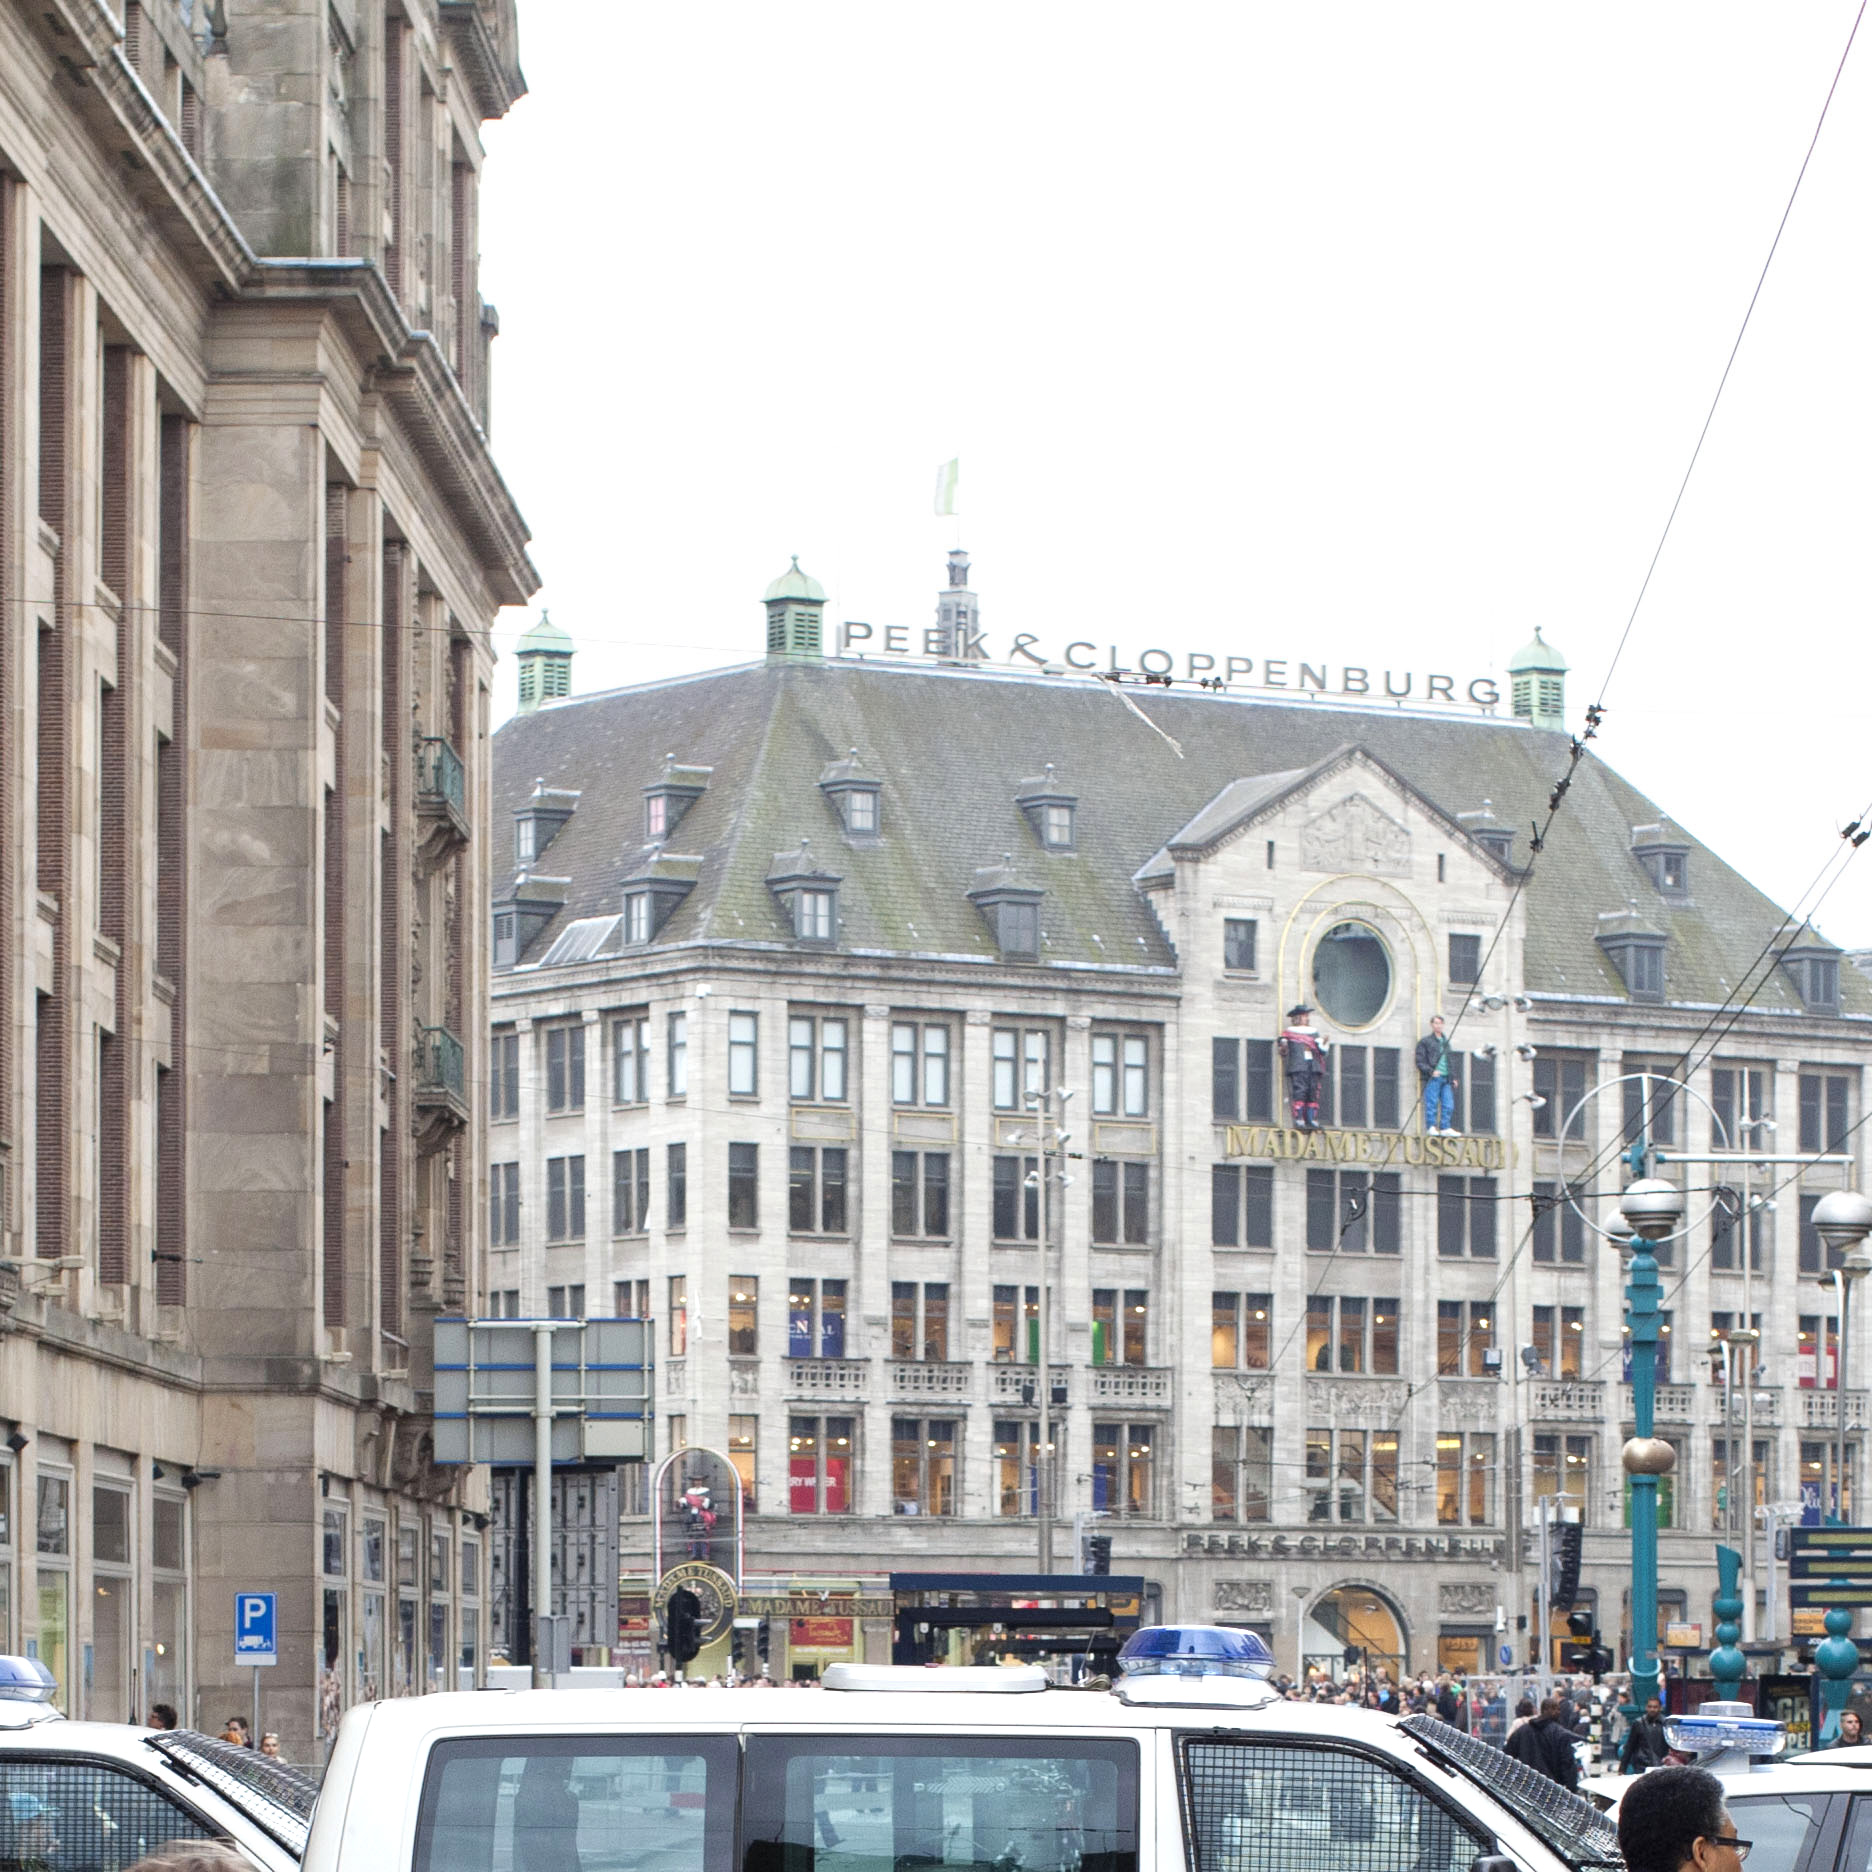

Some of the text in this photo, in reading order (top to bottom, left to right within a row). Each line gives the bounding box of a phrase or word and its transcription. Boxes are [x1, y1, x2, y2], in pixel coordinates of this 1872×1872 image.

[844, 620, 1501, 705] PEEK & CLOPPENBURG
[1227, 1125, 1377, 1162] MADAME
[1184, 1534, 1263, 1552] PEEK
[1298, 1535, 1531, 1556] CLOPPENBUR
[243, 1597, 267, 1630] P
[748, 1598, 823, 1617] MADAME
